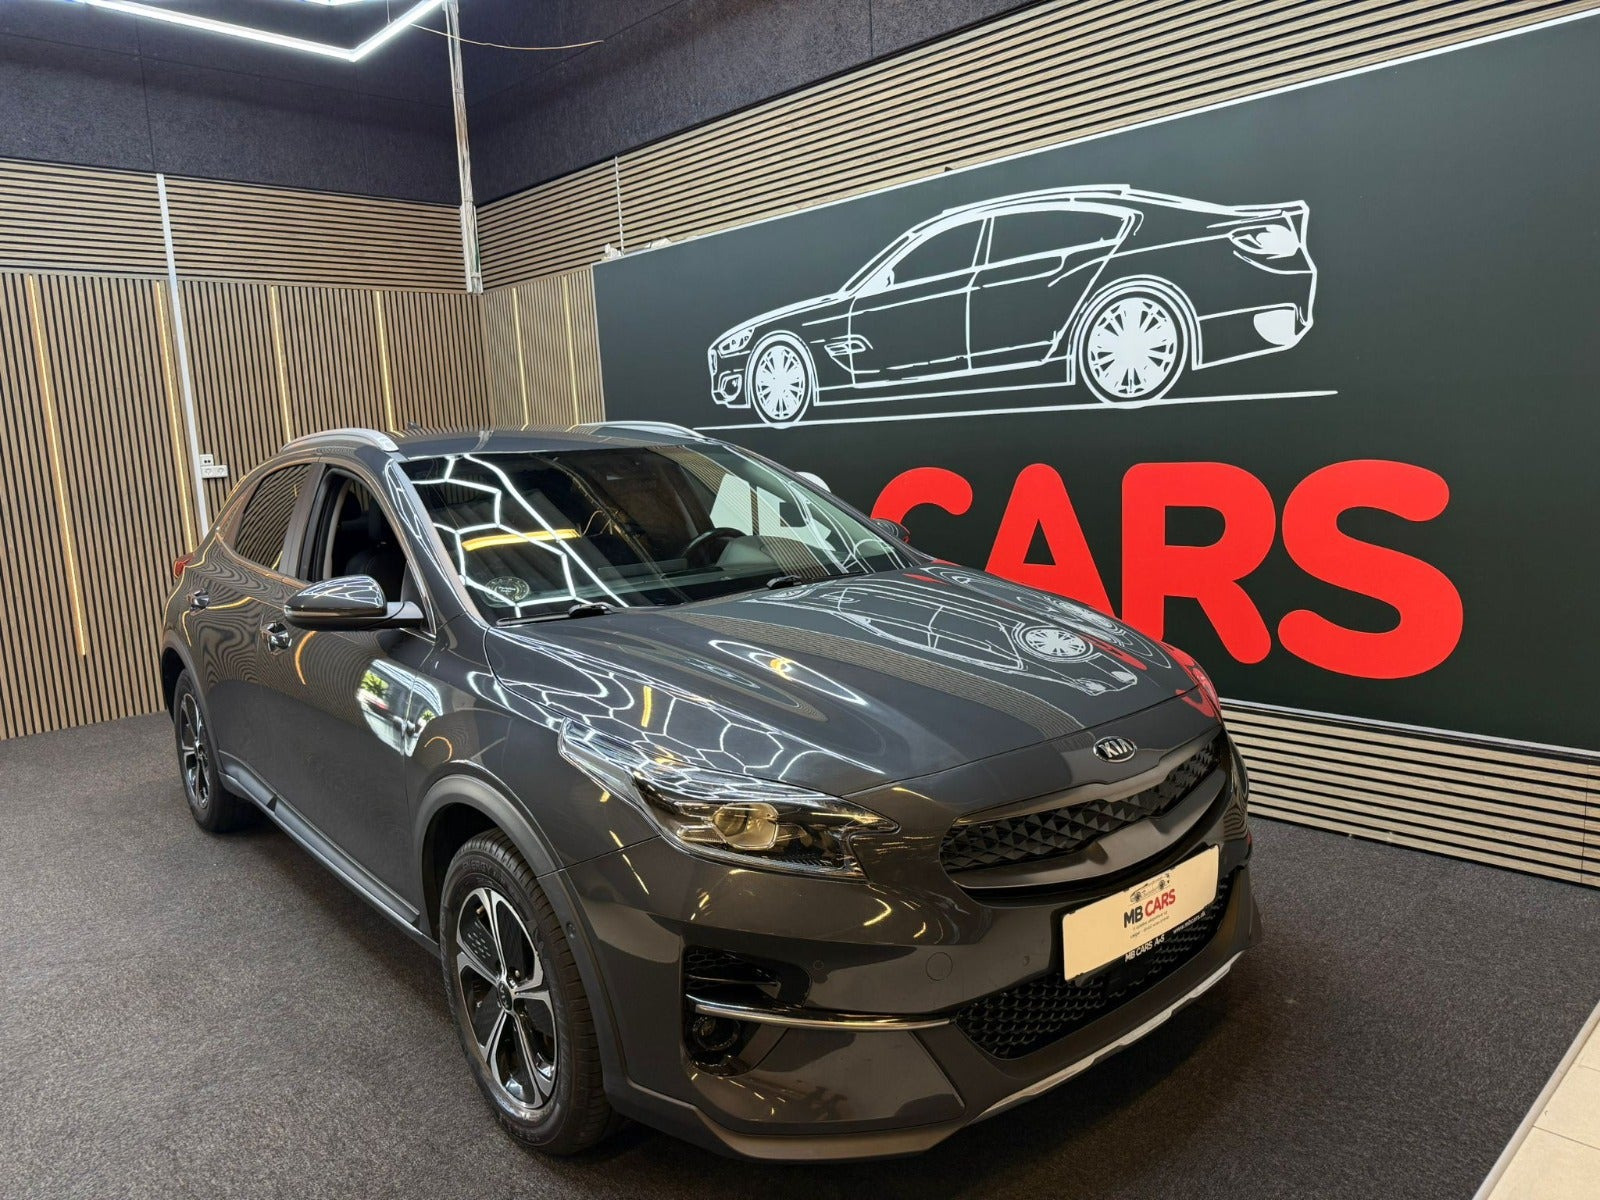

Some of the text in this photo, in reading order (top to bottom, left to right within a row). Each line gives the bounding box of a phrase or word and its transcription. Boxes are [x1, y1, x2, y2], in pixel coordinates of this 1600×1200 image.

[1098, 738, 1133, 758] KIA
[1123, 905, 1144, 928] MB
[1145, 888, 1176, 917] CARS
[1125, 949, 1136, 963] MB
[1135, 940, 1153, 956] CARS
